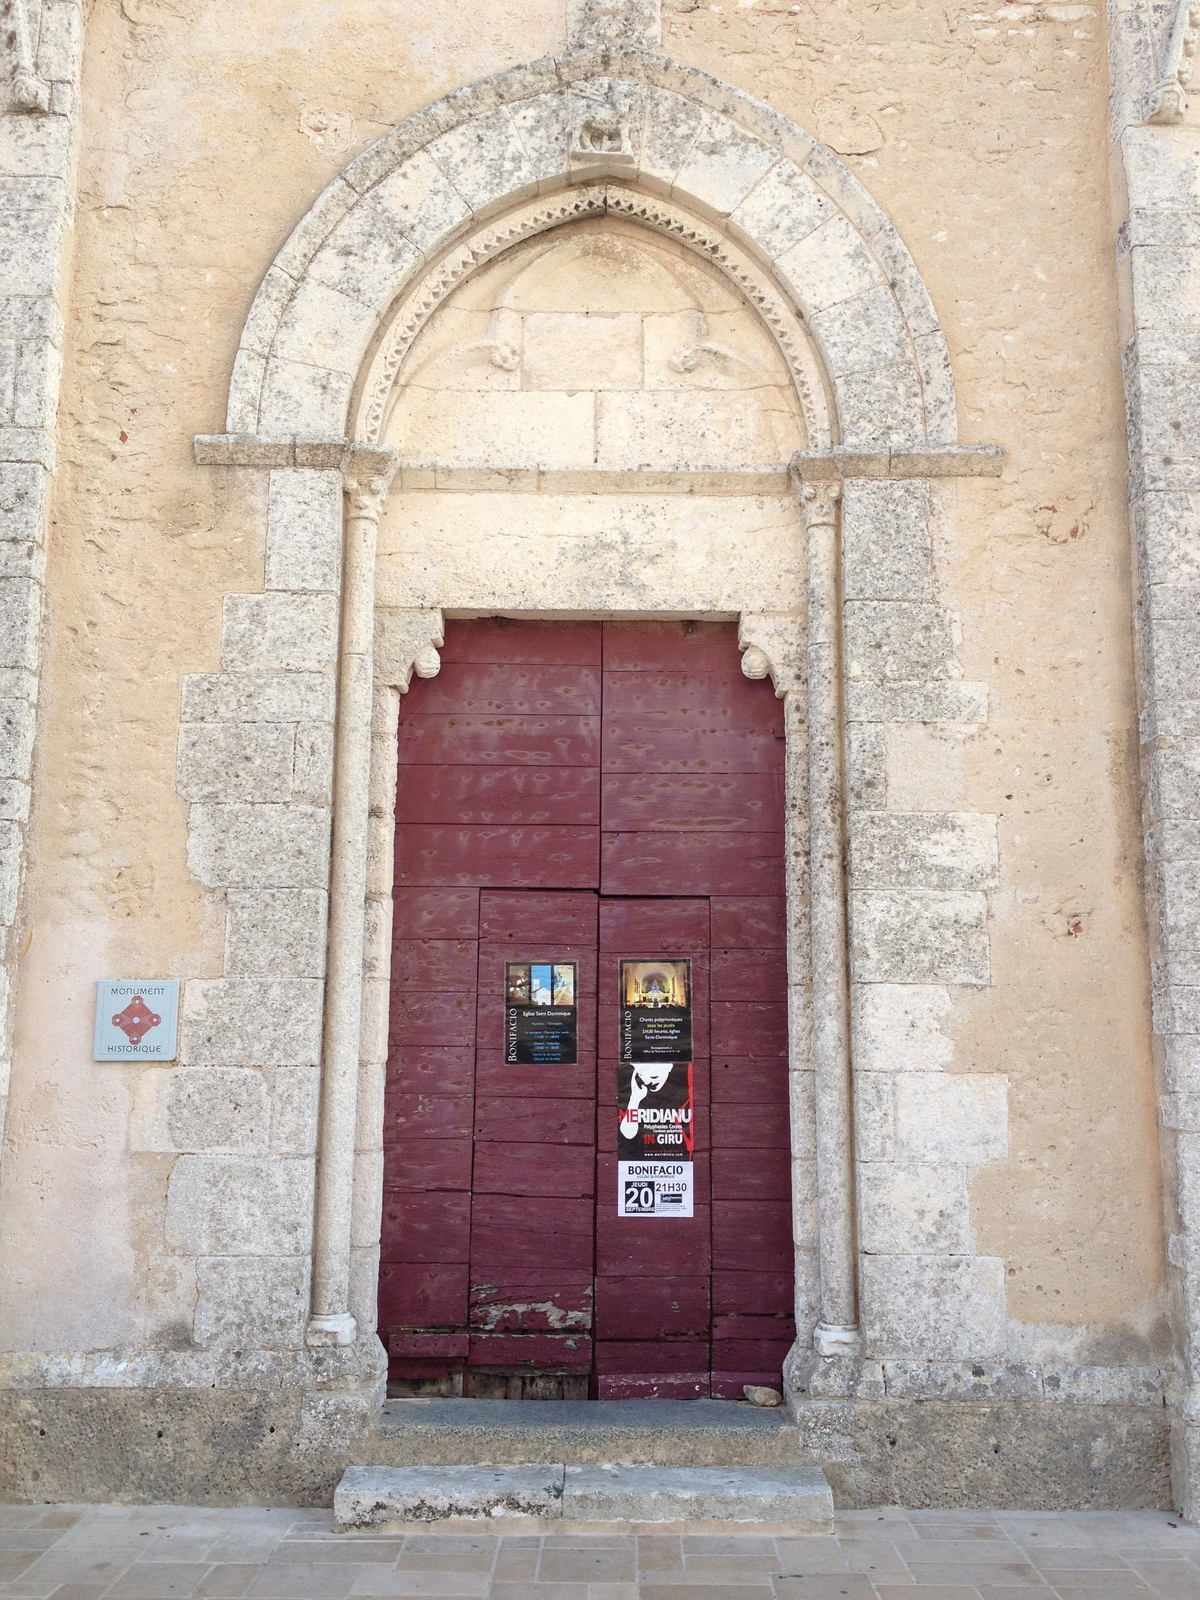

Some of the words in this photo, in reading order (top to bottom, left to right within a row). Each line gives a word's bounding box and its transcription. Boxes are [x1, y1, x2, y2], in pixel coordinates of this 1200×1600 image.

[110, 987, 165, 995] MONUMENT
[508, 1008, 517, 1061] BONIFACIO
[624, 1010, 632, 1059] BONIFACIO
[107, 1045, 162, 1053] HISTORIQUE
[618, 1108, 692, 1123] MERIDIANU
[643, 1134, 655, 1145] IN
[657, 1133, 683, 1145] GIRU
[628, 1165, 683, 1175] BONIFACIO
[655, 1183, 687, 1192] 21H30
[625, 1187, 653, 1208] 20
